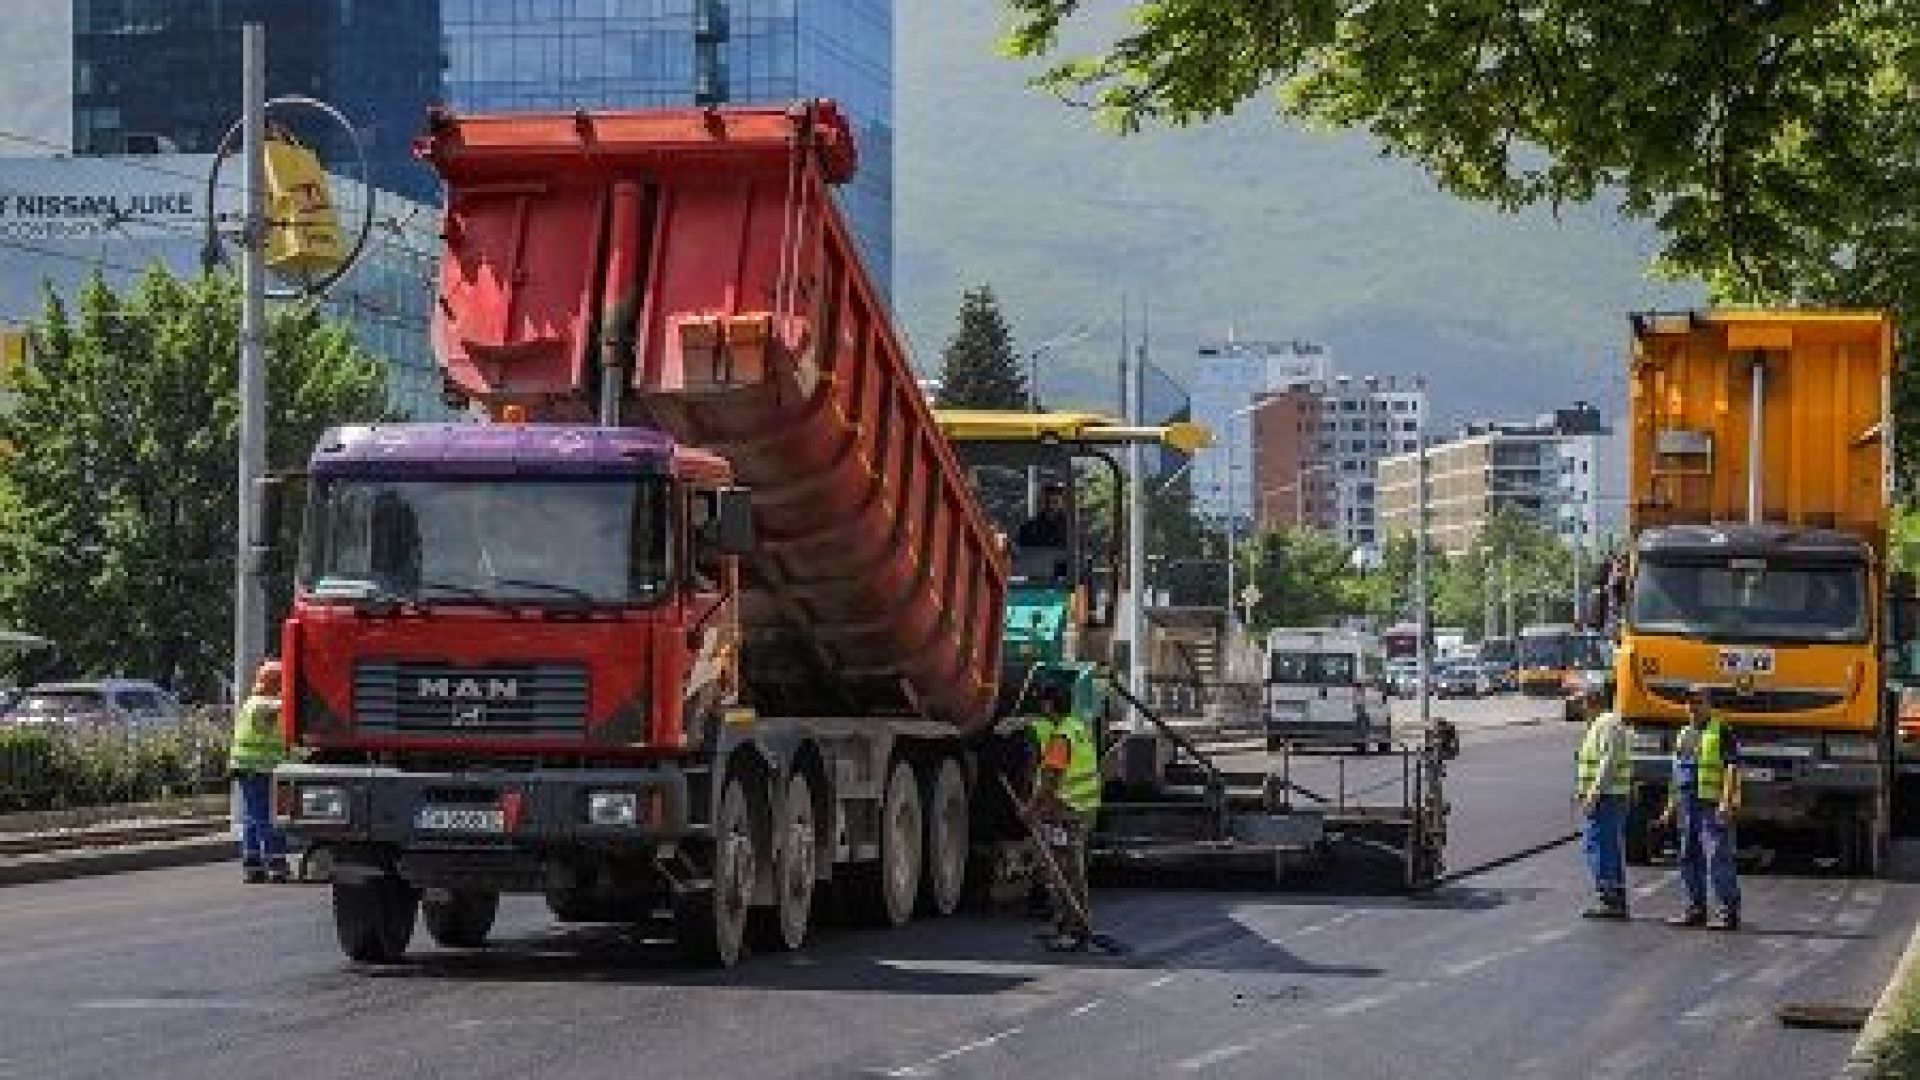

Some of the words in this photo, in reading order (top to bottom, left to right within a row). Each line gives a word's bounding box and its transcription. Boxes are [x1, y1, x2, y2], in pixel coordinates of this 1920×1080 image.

[17, 195, 116, 215] NISSAN
[125, 193, 192, 214] JUKE
[417, 678, 517, 699] MAN
